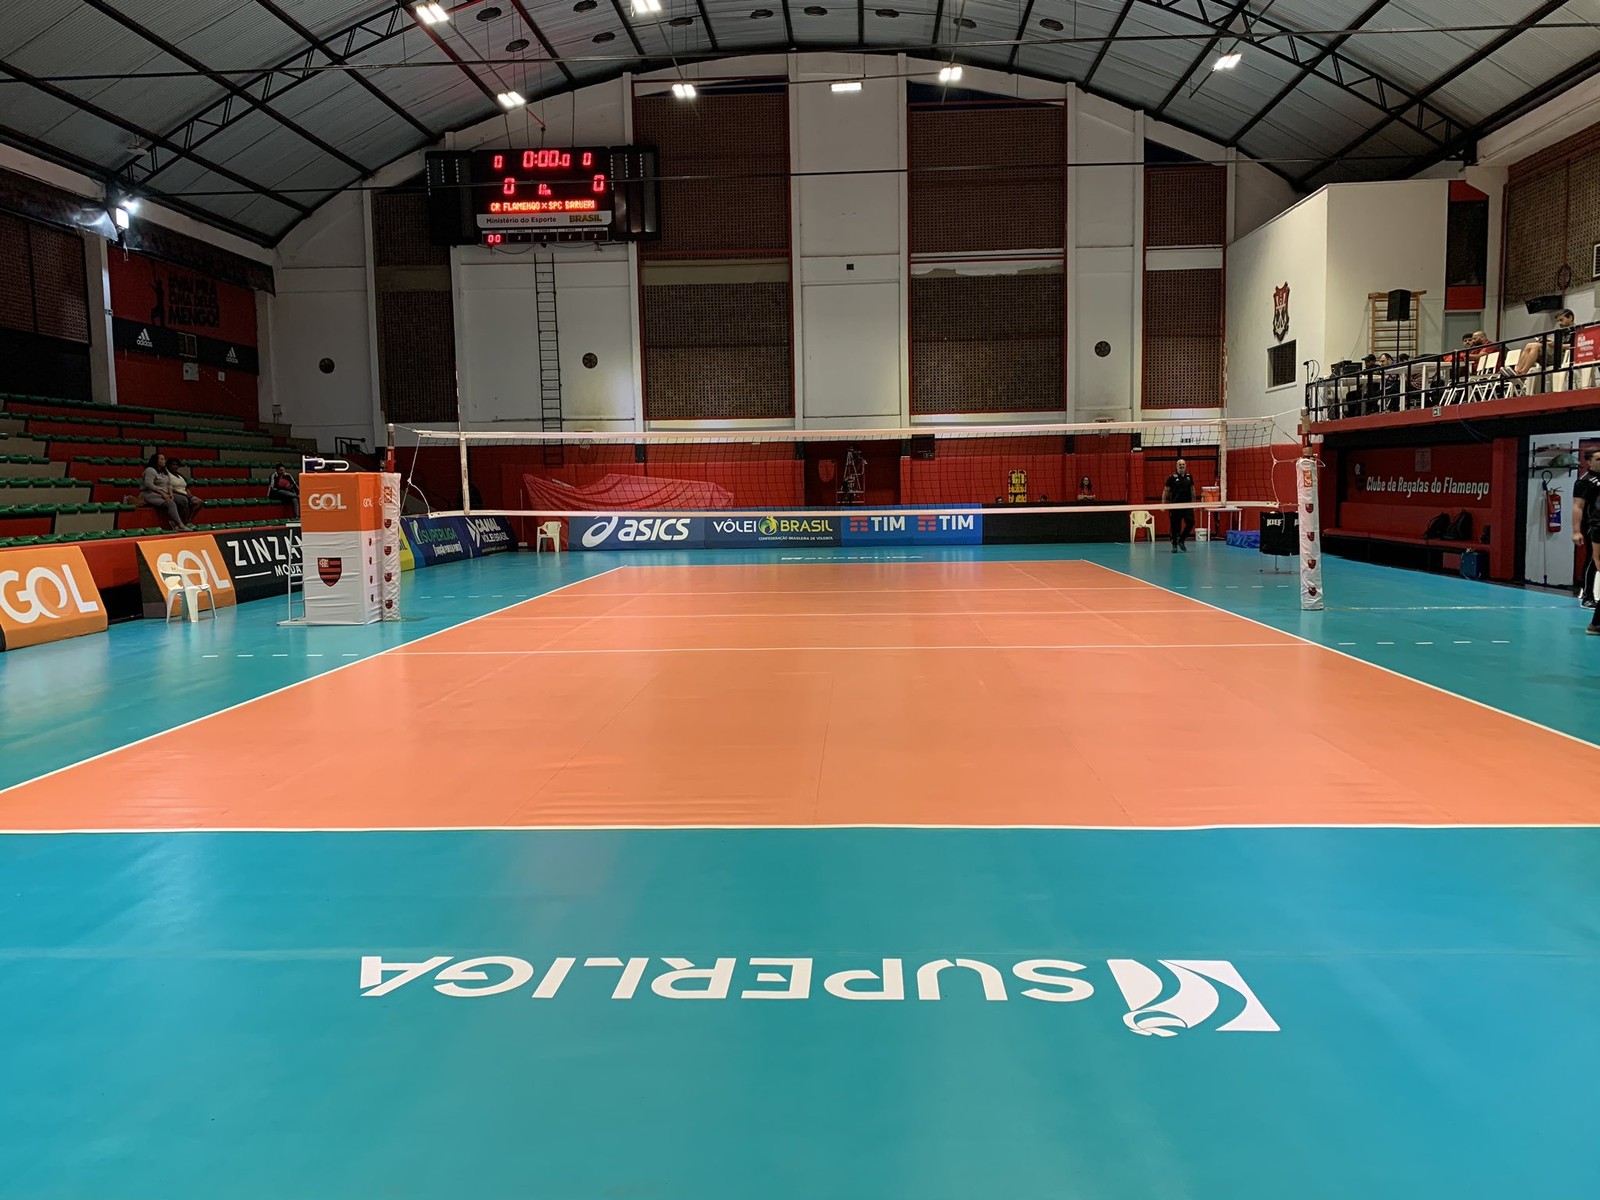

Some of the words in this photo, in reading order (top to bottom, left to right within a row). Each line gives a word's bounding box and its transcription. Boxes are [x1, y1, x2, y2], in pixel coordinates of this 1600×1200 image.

[494, 155, 503, 168] 0
[582, 152, 592, 166] 0
[503, 177, 515, 195] 0
[593, 174, 605, 192] 0
[490, 202, 501, 212] CR
[486, 216, 519, 225] Ministério
[531, 216, 557, 225] Esporte
[569, 214, 603, 223] BRASIL
[136, 339, 154, 348] adidas
[1366, 476, 1386, 491] Clube
[1387, 476, 1397, 492] de
[1397, 476, 1430, 498] Regatas
[1430, 476, 1442, 494] do
[1443, 476, 1490, 500] Flamengo
[308, 493, 348, 511] GOL
[712, 518, 757, 533] VÔLEI
[780, 519, 834, 533] BRASIL
[870, 516, 906, 532] TIM
[939, 514, 974, 531] TIM
[0, 563, 99, 625] GOL
[359, 956, 1095, 1001] SUPERLIGA
